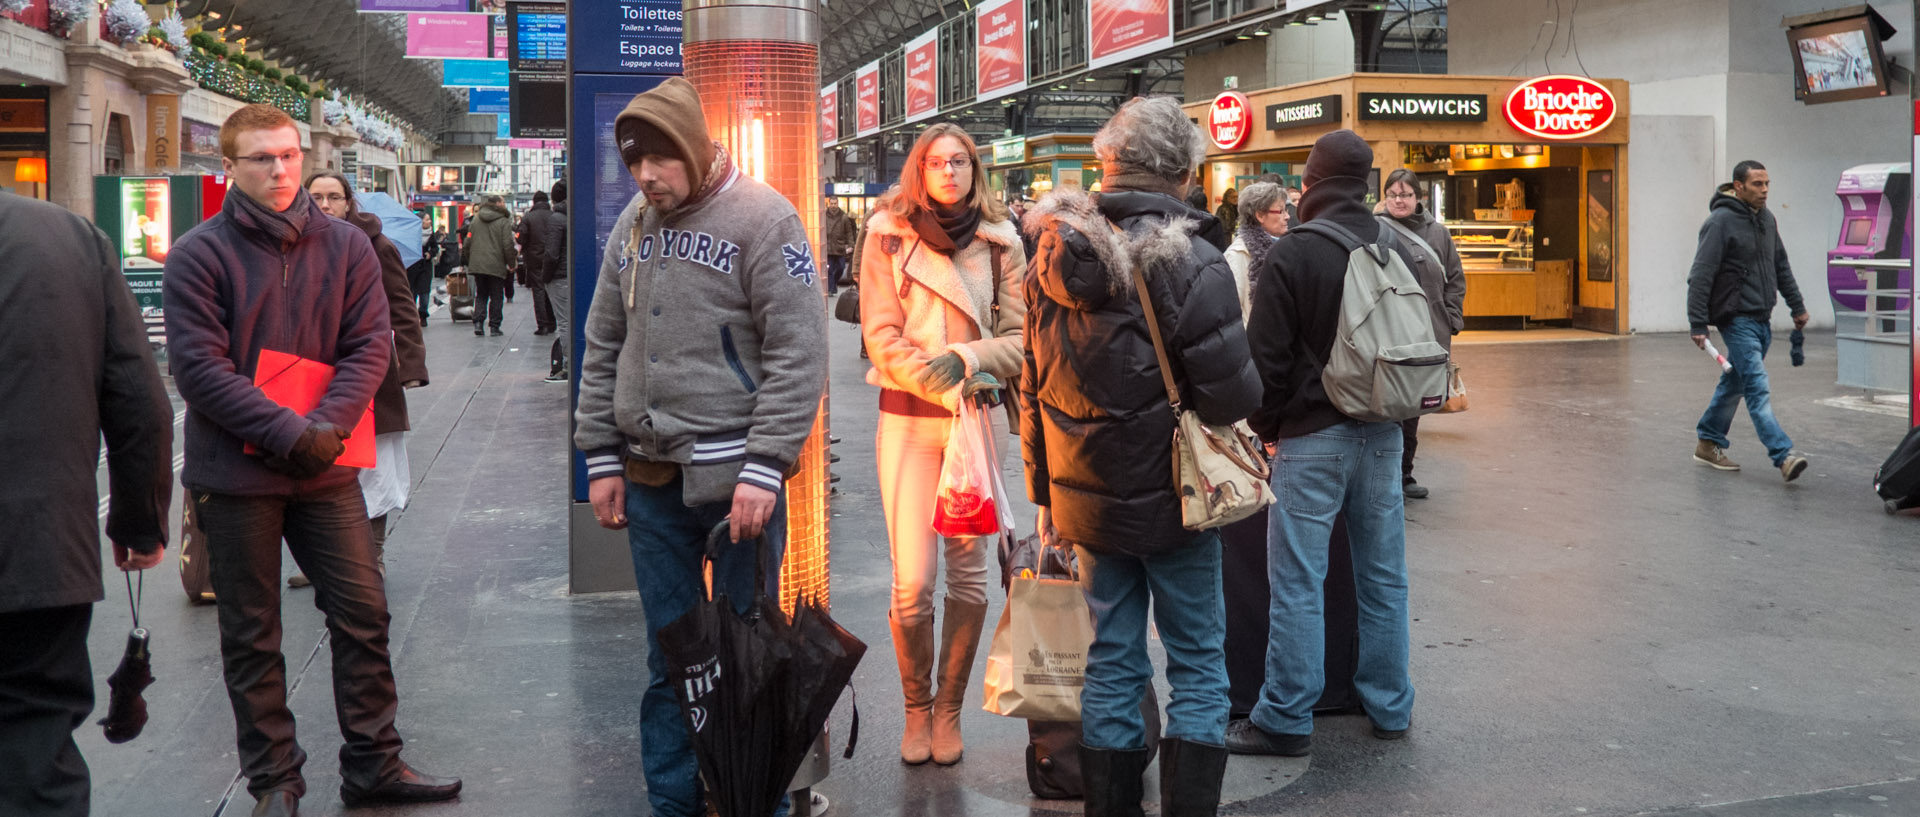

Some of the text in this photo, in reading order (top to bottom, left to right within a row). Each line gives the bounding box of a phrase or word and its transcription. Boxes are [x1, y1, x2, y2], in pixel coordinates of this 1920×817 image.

[620, 5, 683, 20] Toilettes
[620, 41, 674, 57] Espace
[620, 60, 652, 68] Luggage
[1369, 98, 1481, 115] SANDWICHS
[1524, 85, 1604, 115] Brioche
[1275, 103, 1323, 123] PATISSERIES
[660, 228, 740, 274] YORK
